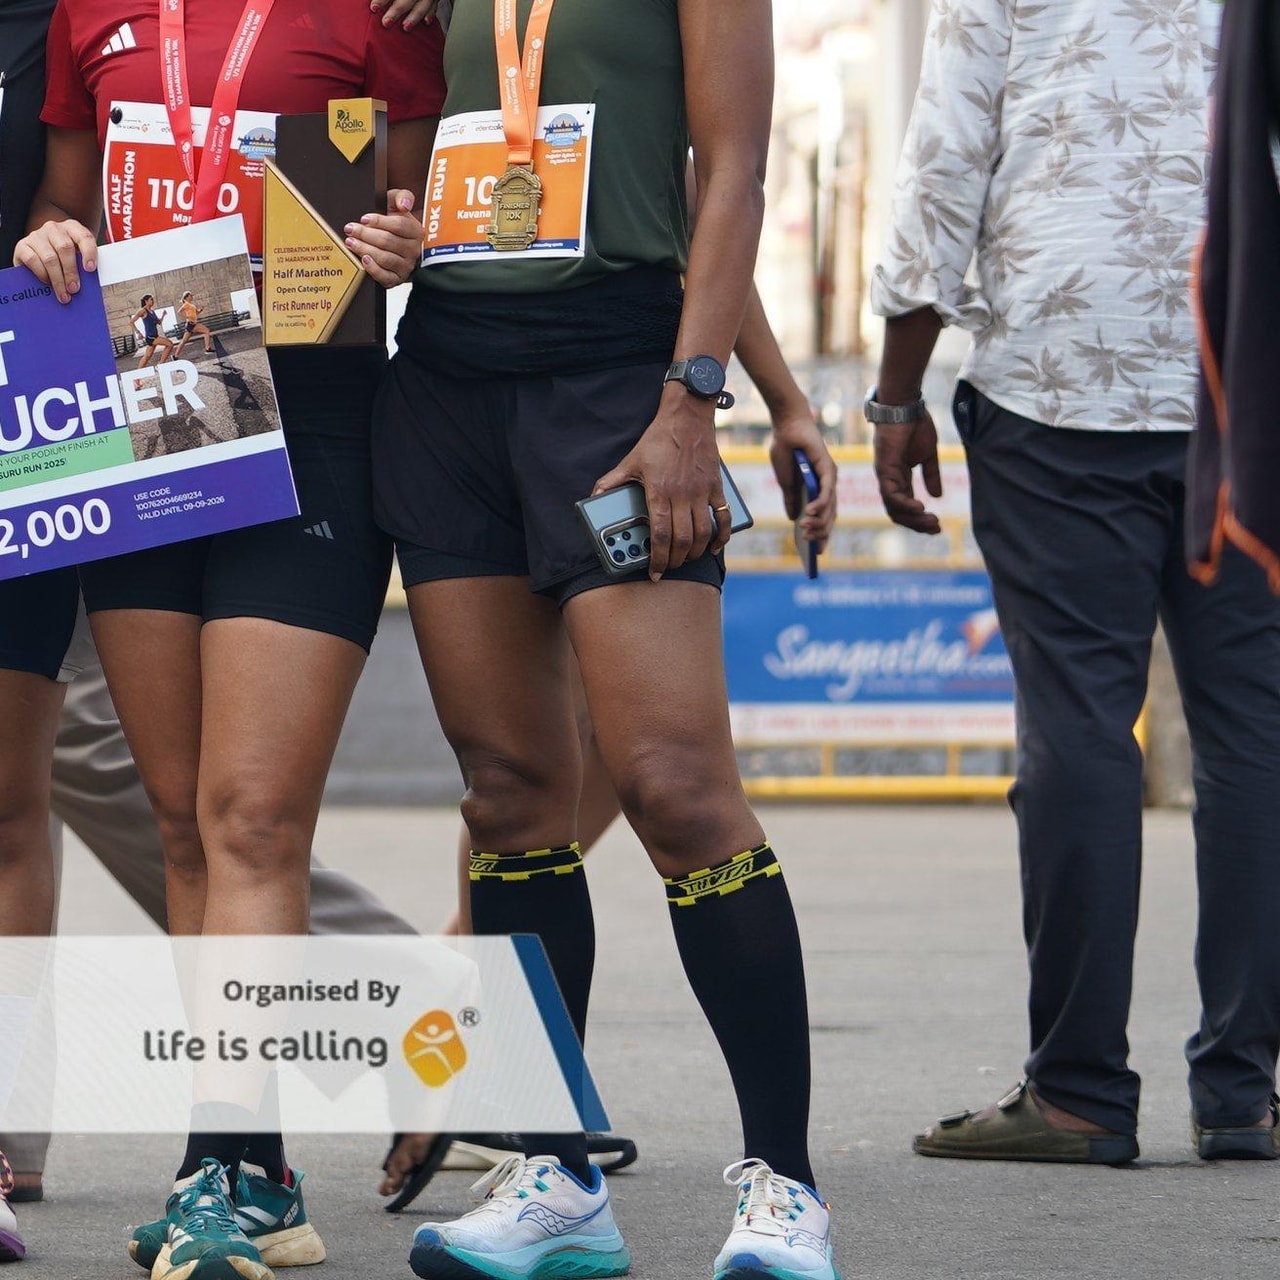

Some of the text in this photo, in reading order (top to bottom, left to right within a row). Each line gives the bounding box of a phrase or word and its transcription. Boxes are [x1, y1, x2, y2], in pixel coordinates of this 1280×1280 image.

[224, 10, 255, 81] CELEBRATION MYSURU
[166, 66, 176, 111] CELEBRATION
[335, 118, 364, 133] Apollo
[342, 126, 368, 134] HOSPITAL
[219, 127, 227, 145] calling
[111, 173, 121, 215] HALF
[123, 150, 136, 239] MARATHON
[427, 157, 448, 242] 10K RUN
[500, 202, 530, 210] FINISHER
[505, 211, 522, 220] 10K
[273, 268, 343, 279] Half Marathon
[12, 284, 52, 306] calling
[276, 285, 331, 294] Open Category
[273, 300, 331, 311] First Runner Up
[4, 455, 30, 465] YOUR
[31, 446, 67, 460] PODIUM
[68, 439, 97, 451] FINISH
[98, 436, 109, 445] AT
[23, 464, 42, 474] RUN
[134, 487, 171, 501] USE CODE
[138, 510, 160, 520] VALID
[161, 506, 182, 516] UNTIL
